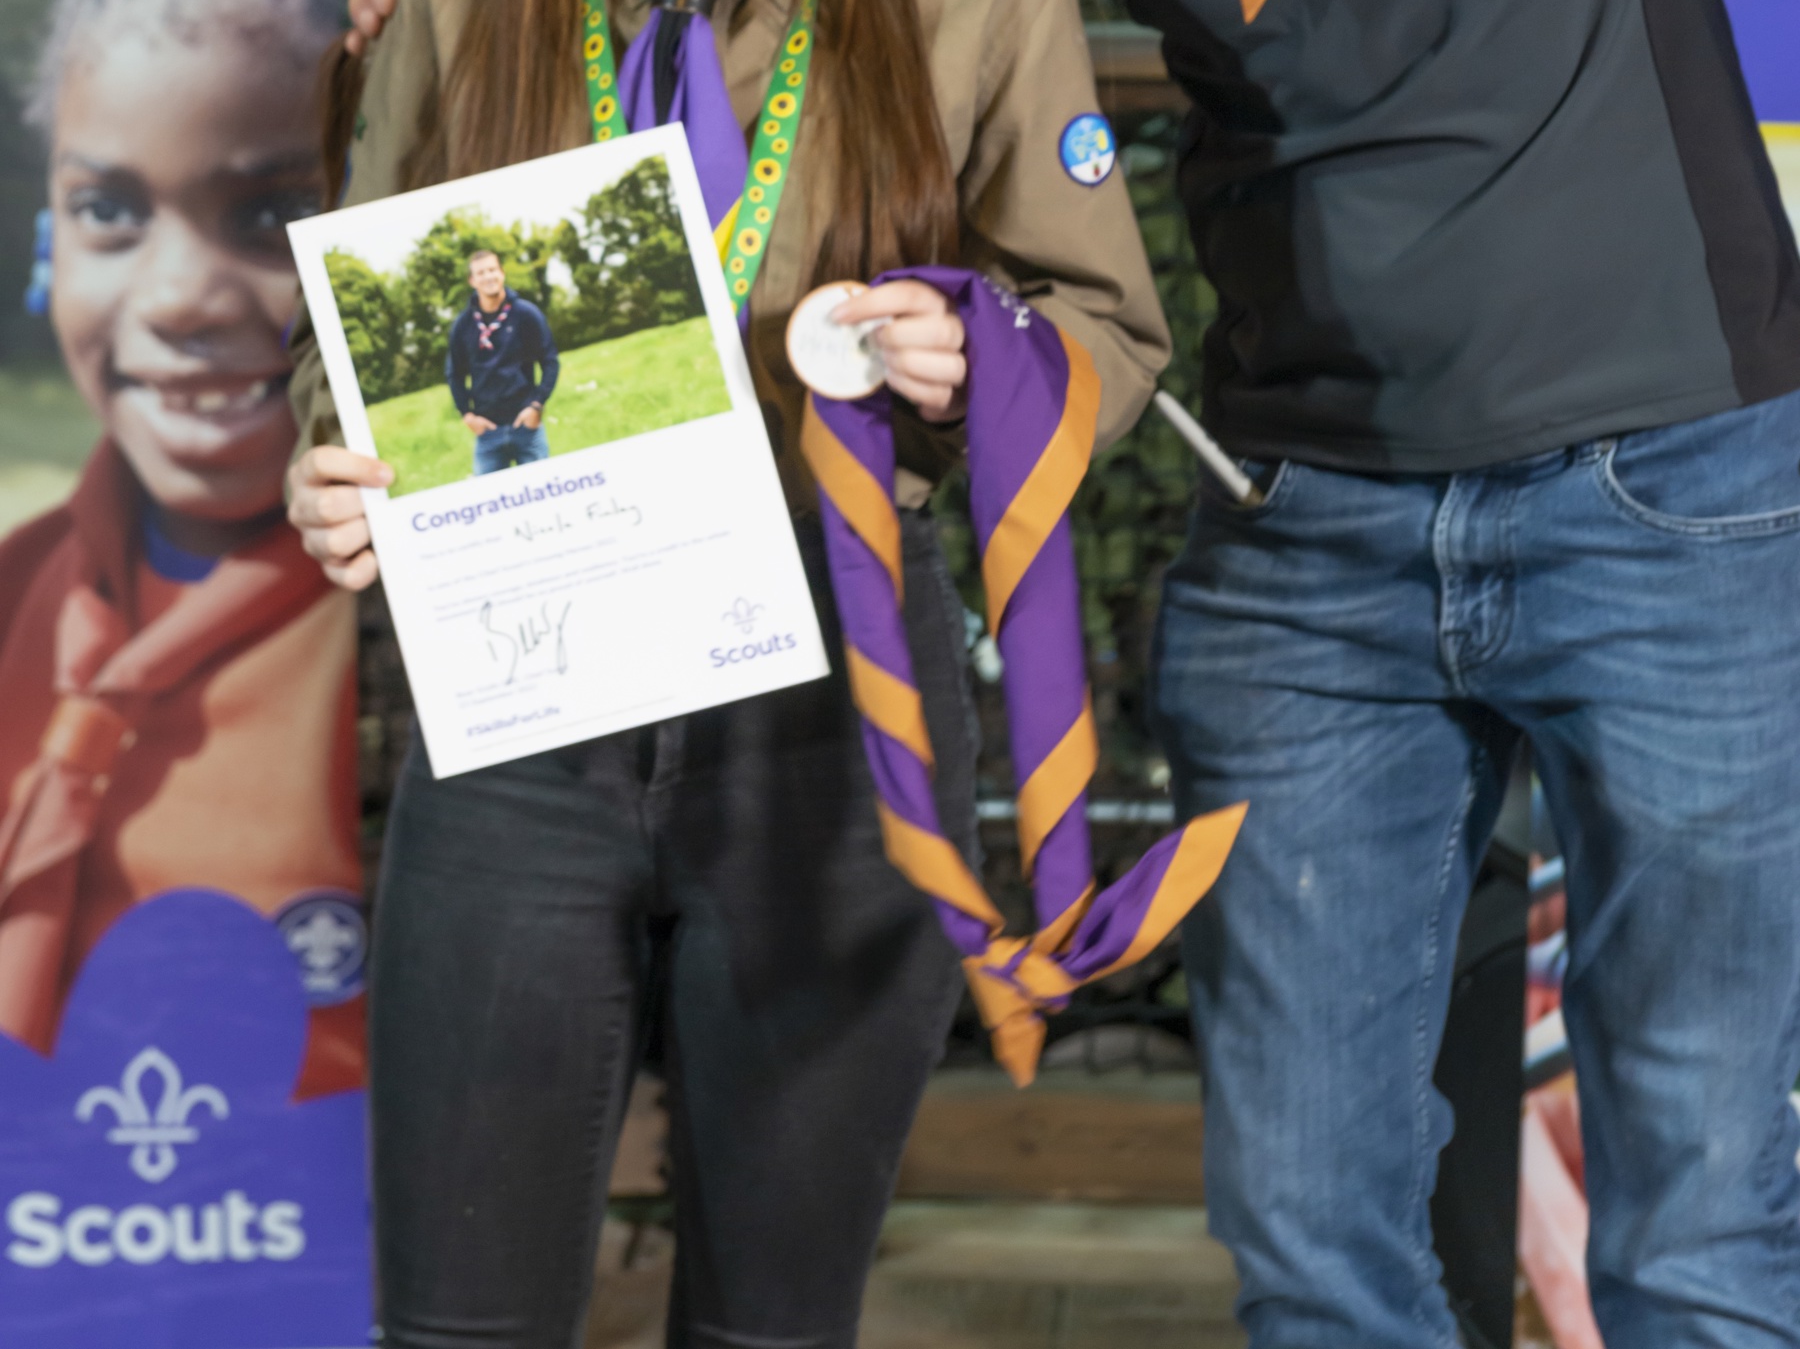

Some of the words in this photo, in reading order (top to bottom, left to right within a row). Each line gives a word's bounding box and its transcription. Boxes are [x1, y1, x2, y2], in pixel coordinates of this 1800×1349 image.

[411, 471, 606, 532] Congratulations
[709, 633, 797, 669] Scouts
[7, 1190, 306, 1268] Scouts
